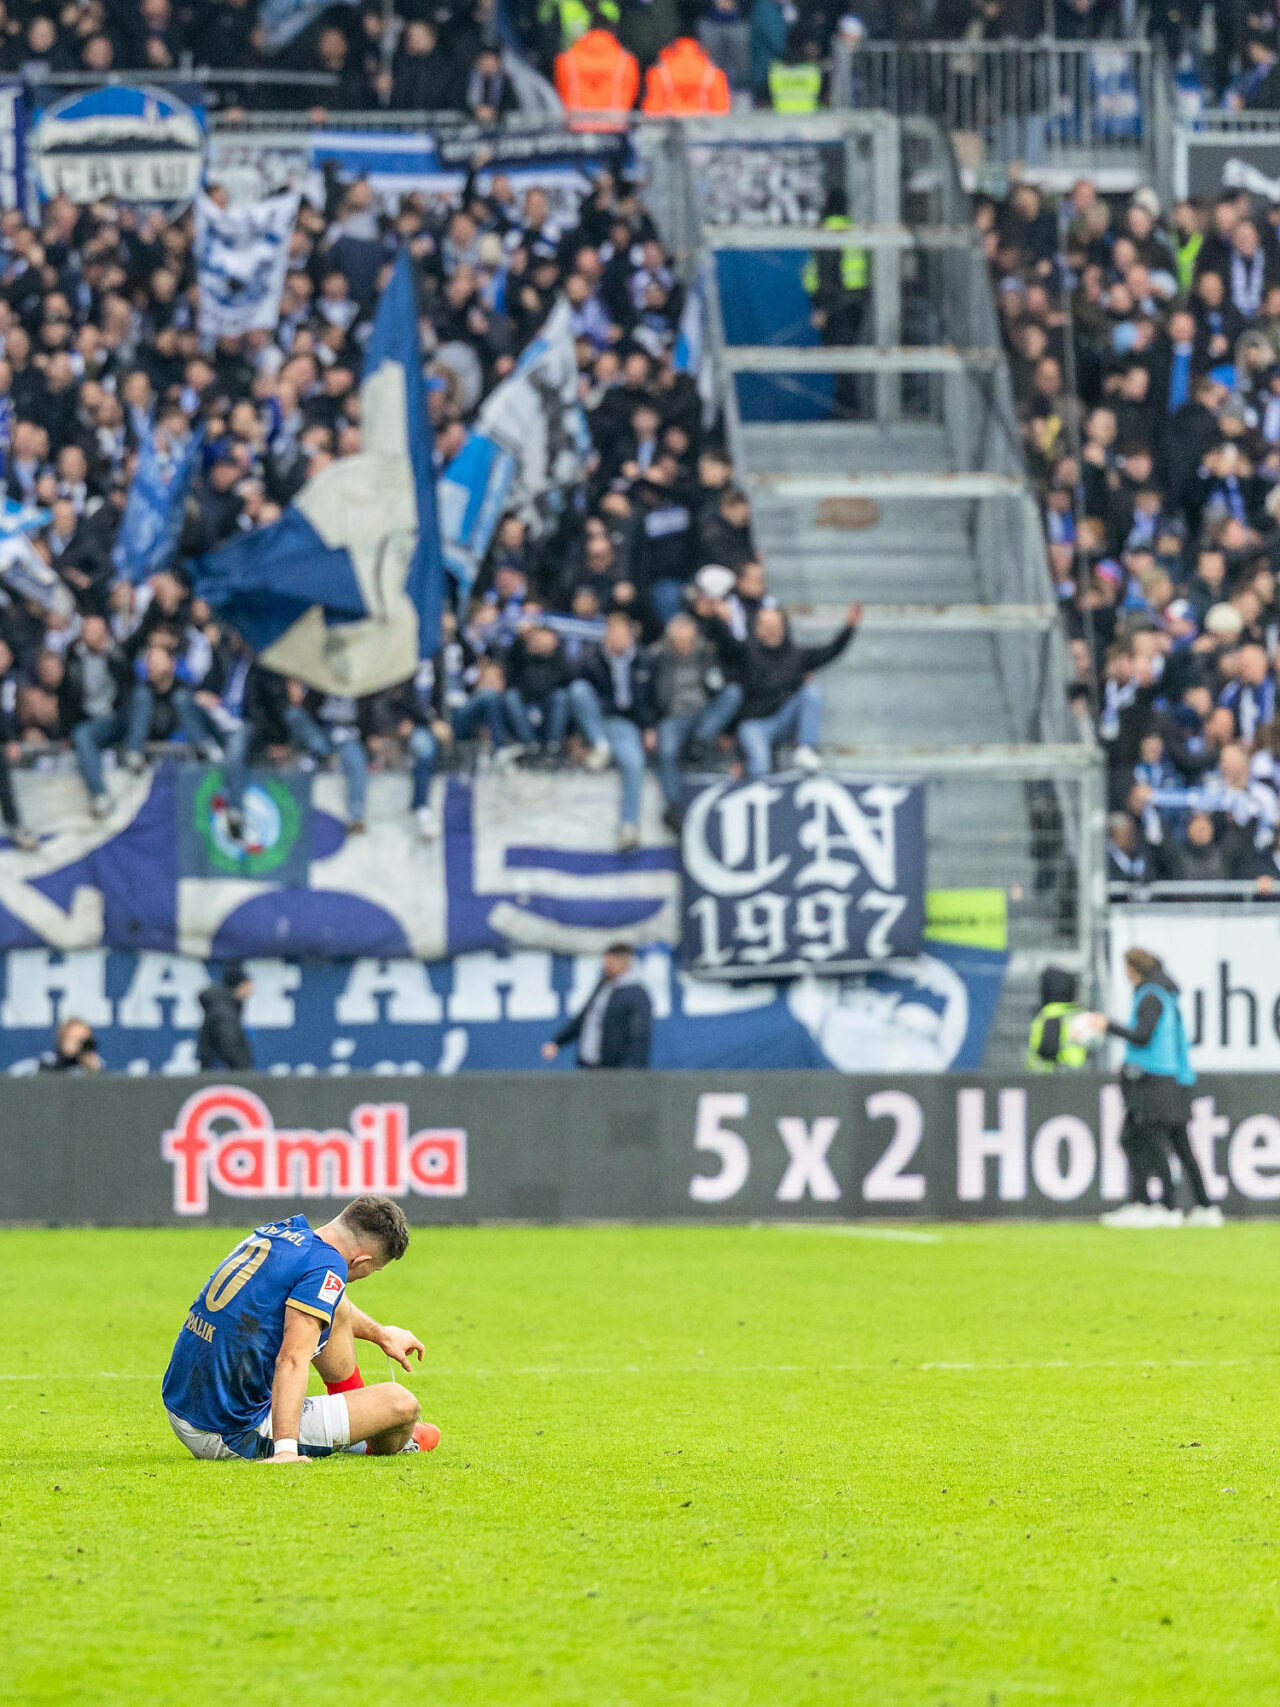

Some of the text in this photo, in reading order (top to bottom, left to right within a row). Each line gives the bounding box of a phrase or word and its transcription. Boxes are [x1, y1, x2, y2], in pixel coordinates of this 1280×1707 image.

[683, 780, 911, 895] CN
[689, 895, 908, 964] 1997
[163, 1084, 466, 1214] famila
[689, 1084, 1280, 1201] 5 x 2 Holte
[205, 1235, 272, 1313] 0
